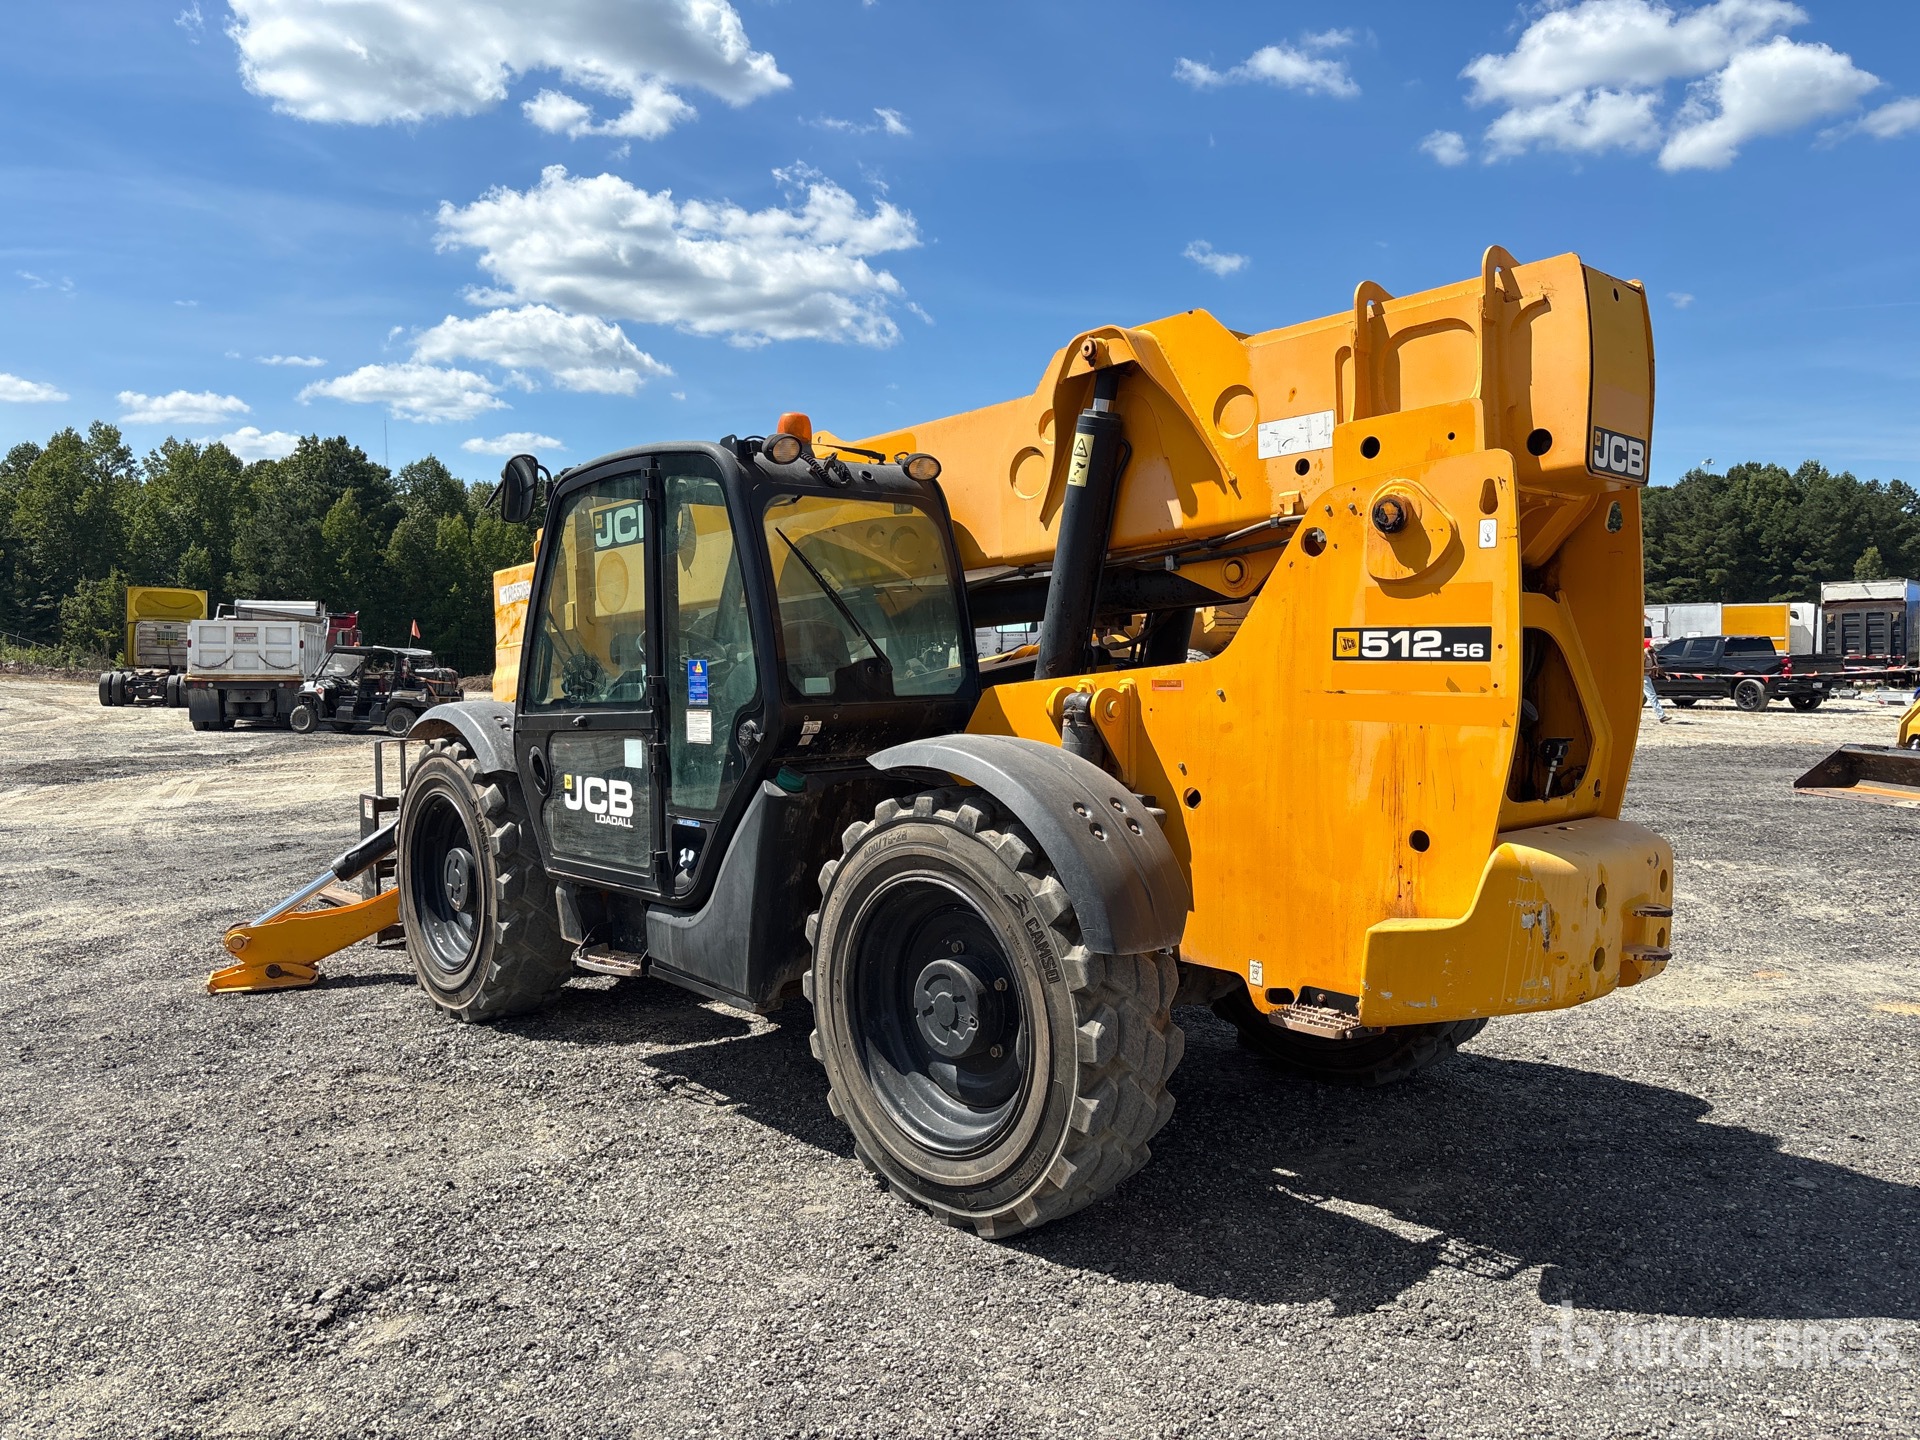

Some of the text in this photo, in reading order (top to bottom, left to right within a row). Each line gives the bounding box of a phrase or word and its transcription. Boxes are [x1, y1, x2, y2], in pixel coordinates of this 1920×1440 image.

[1594, 433, 1644, 476] JCB
[1340, 630, 1484, 658] JCB 512-56
[564, 775, 634, 818] JCB
[475, 812, 490, 854] CAMSO
[594, 814, 633, 828] LOADALL
[1025, 916, 1060, 985] CAMSO
